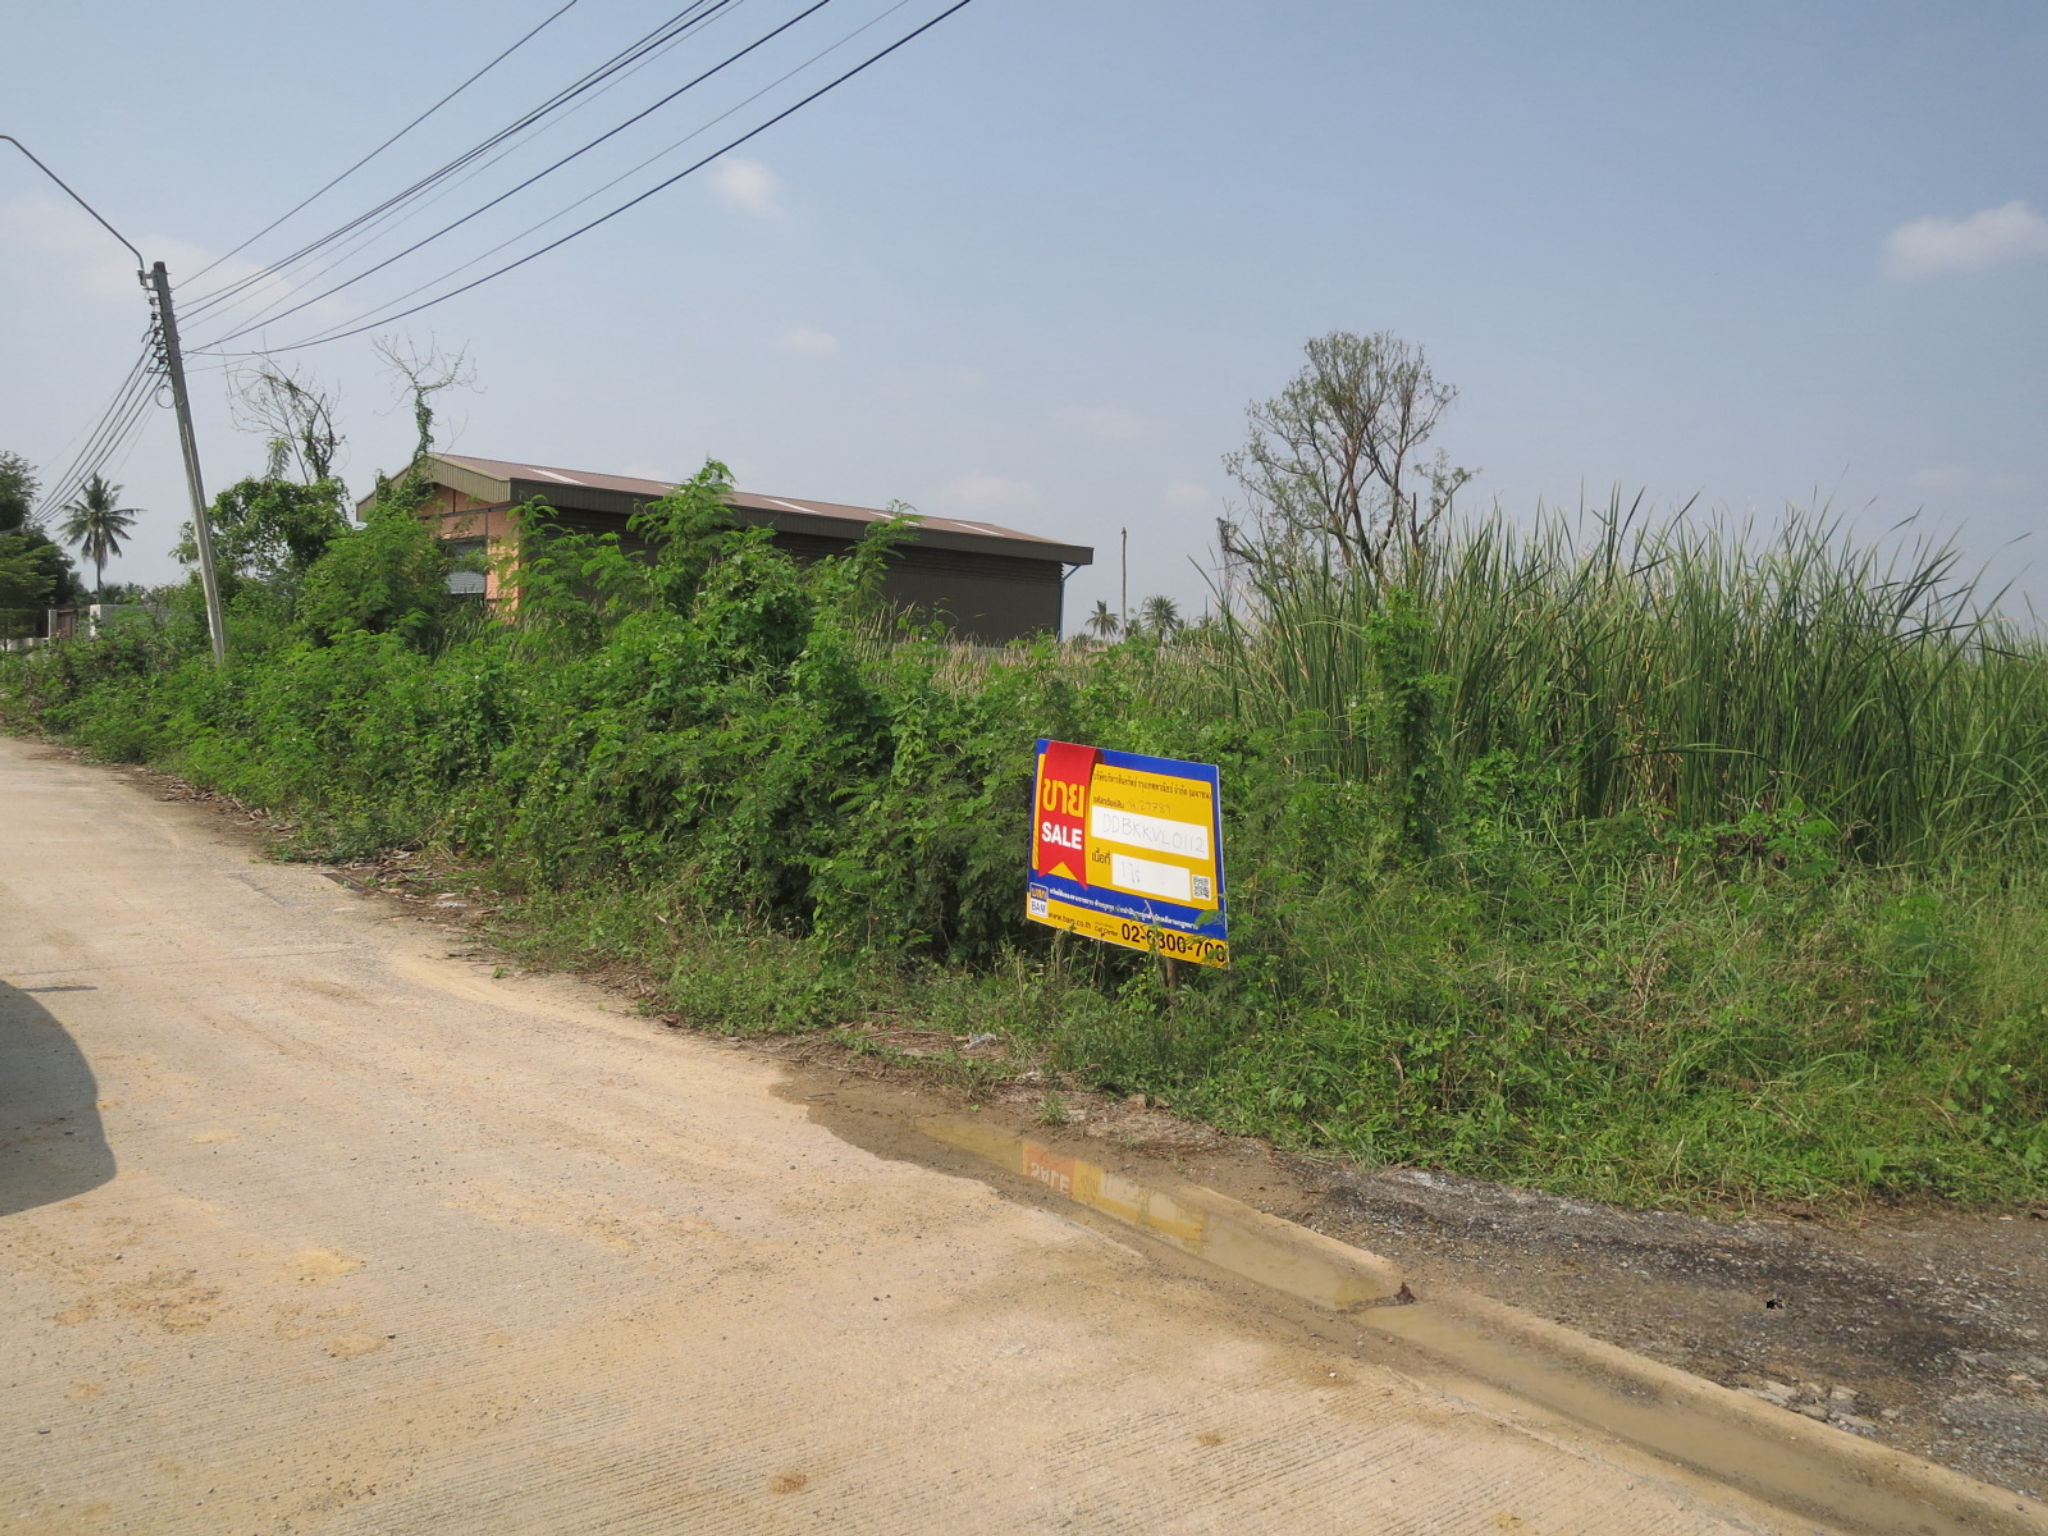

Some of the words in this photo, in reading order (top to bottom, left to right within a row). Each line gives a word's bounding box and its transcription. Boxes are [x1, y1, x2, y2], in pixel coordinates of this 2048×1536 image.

[1043, 778, 1085, 818] ขาย
[1041, 821, 1083, 850] SALE
[1031, 901, 1046, 913] BAM
